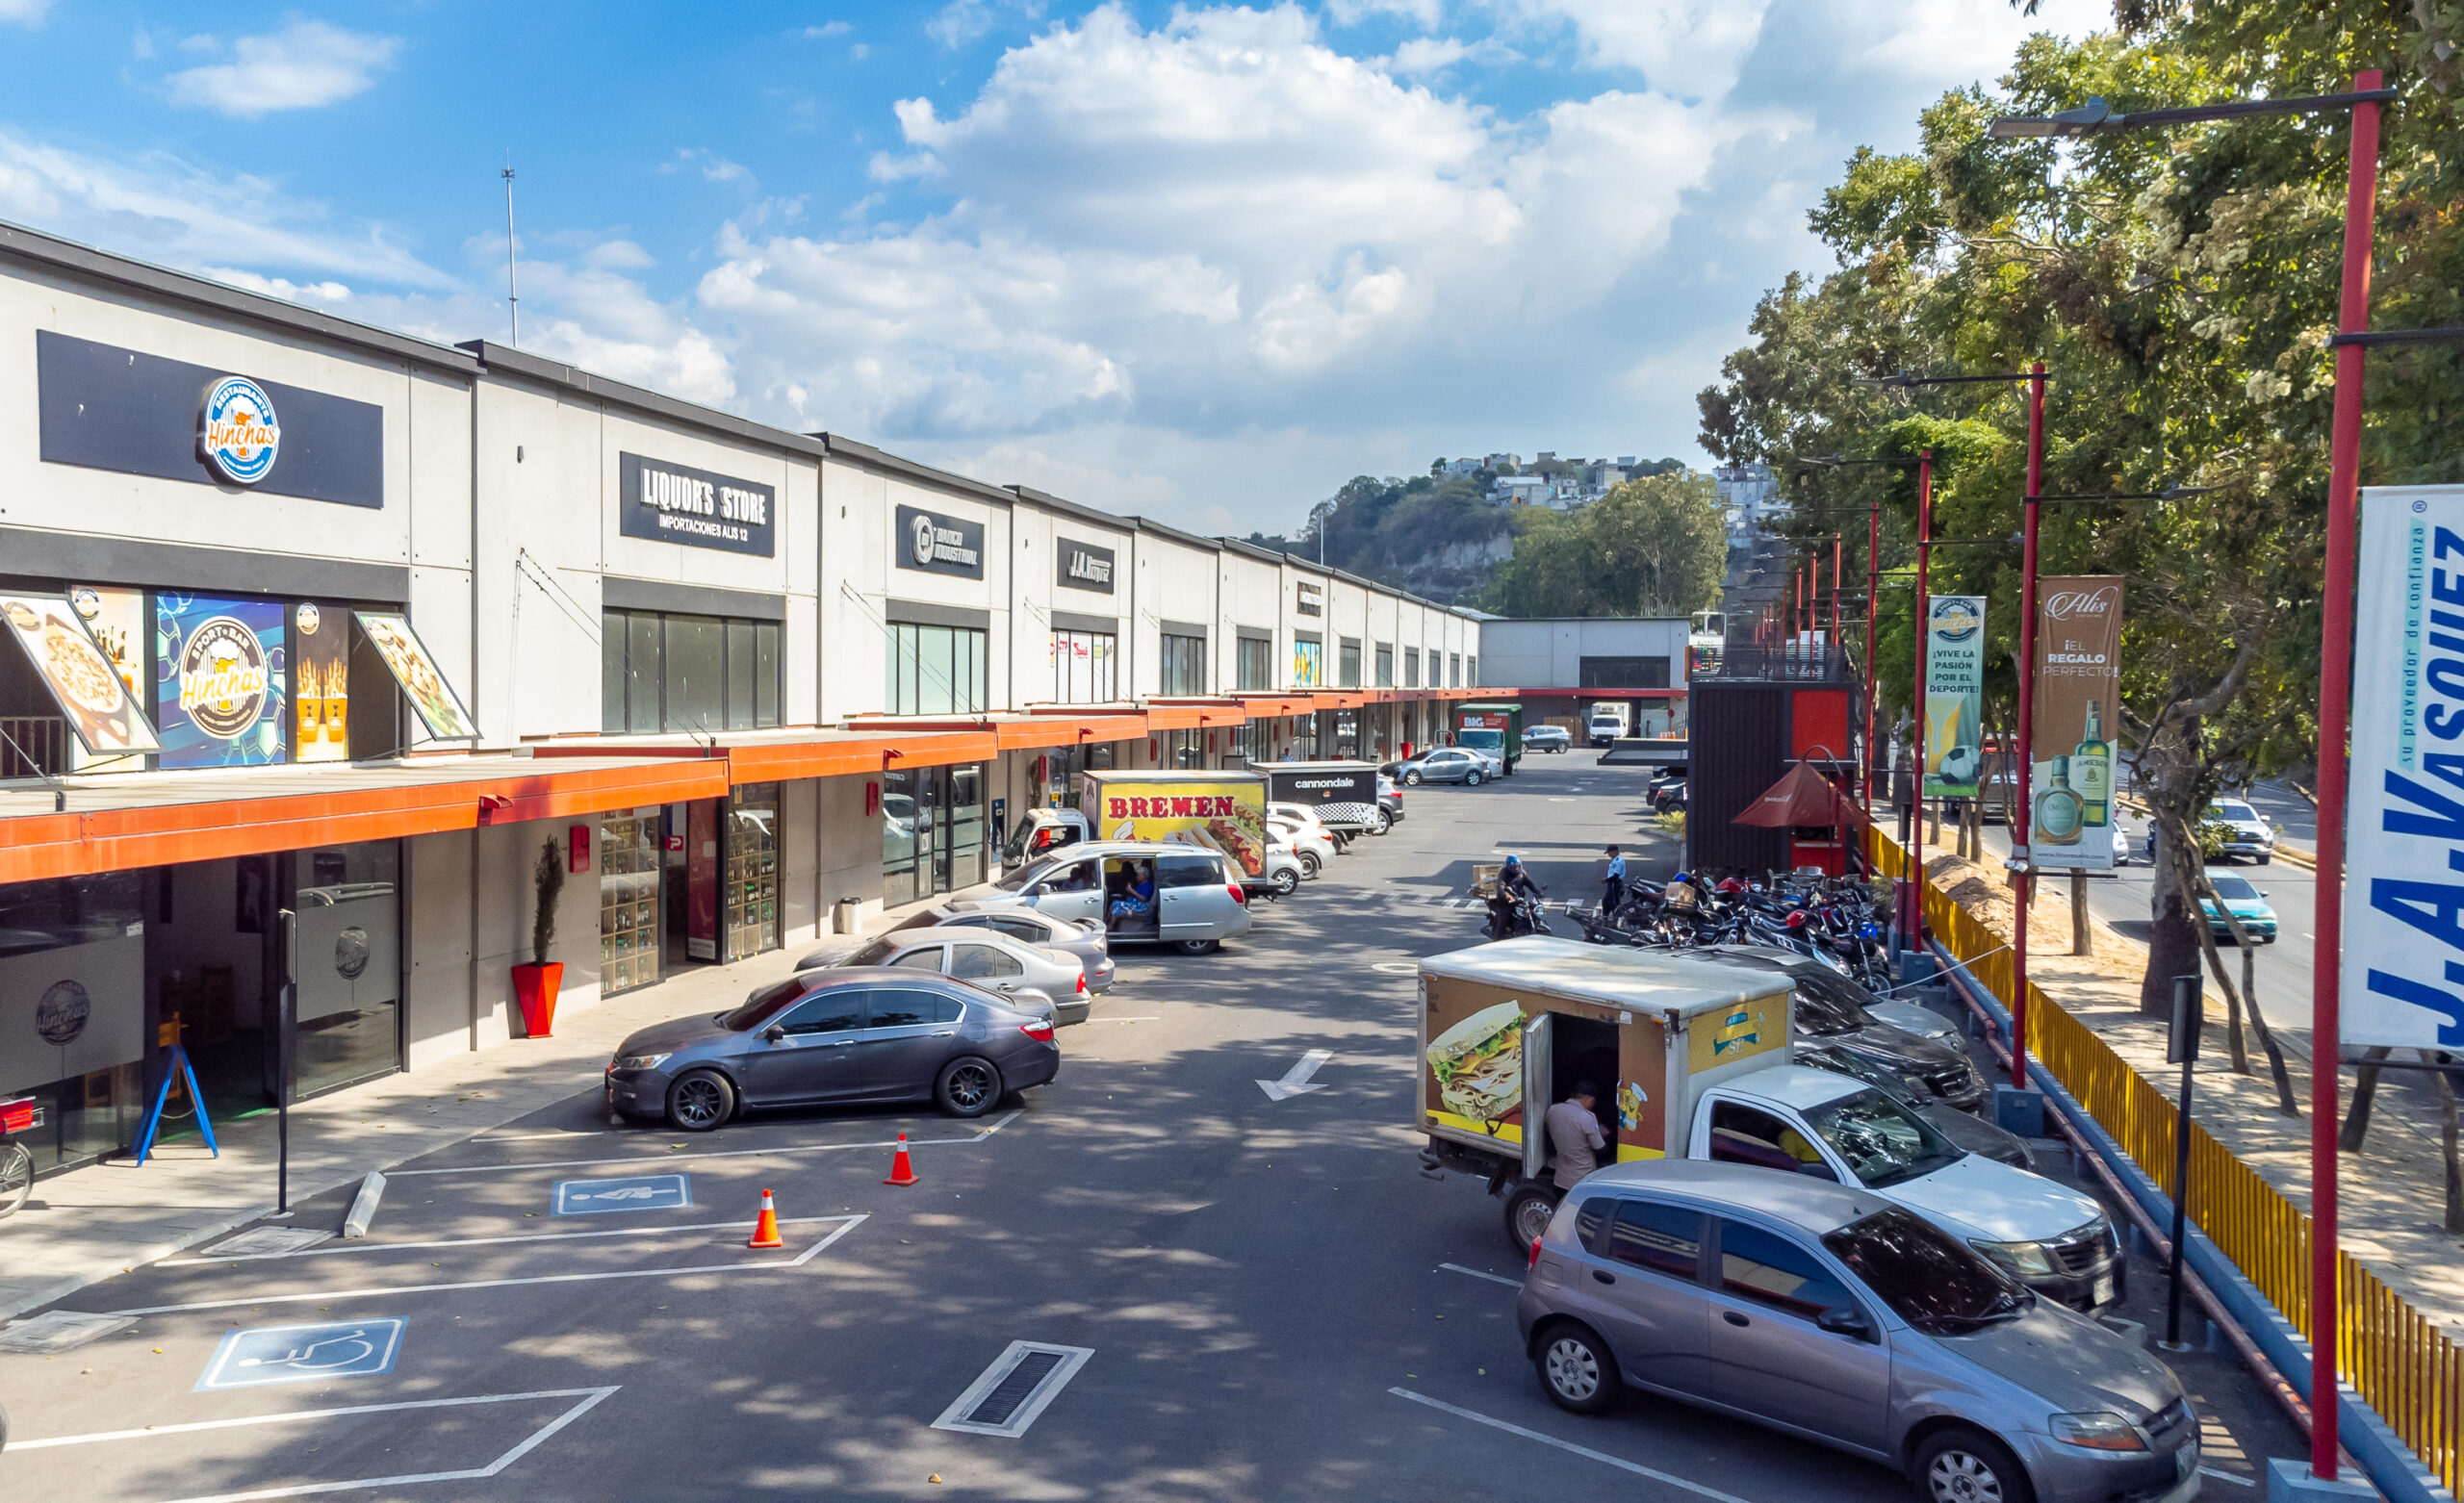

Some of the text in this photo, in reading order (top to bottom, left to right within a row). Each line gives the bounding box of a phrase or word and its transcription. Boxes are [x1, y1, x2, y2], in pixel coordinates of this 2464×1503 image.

[215, 385, 270, 419] RESTAURANTE
[208, 421, 275, 448] Hinchas
[641, 468, 766, 524] LIQUOR'S STORE
[658, 513, 749, 542] IMPORTACIONES ALIS 12
[935, 544, 978, 566] INDUSTRIAL
[2043, 585, 2119, 622] Alis
[192, 625, 250, 660] SPORT BAR
[2402, 527, 2425, 763] su proveedor de confianza
[1933, 650, 1975, 659] ¡VIVE LA
[1935, 659, 1973, 670] PASIÓN
[2047, 653, 2106, 664] REGALO
[1935, 673, 1972, 681] POR EL
[2042, 666, 2118, 677] PERFECTO!
[182, 667, 263, 707] Hinchas
[1929, 685, 1980, 694] DEPORTE!
[1464, 716, 1484, 727] BIG
[1295, 777, 1355, 789] cannondale
[1108, 796, 1235, 819] BREMEN
